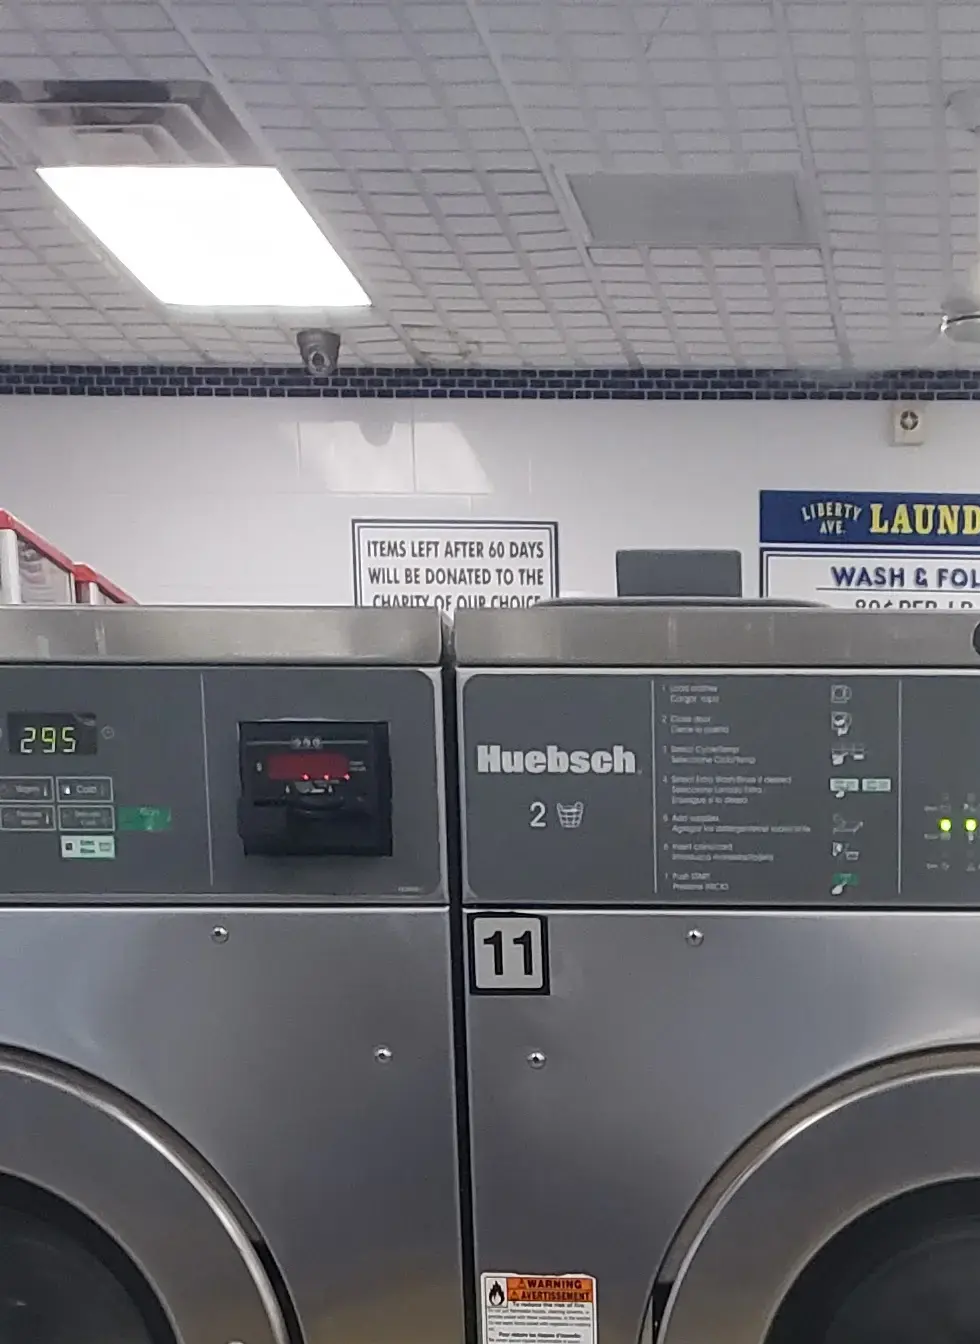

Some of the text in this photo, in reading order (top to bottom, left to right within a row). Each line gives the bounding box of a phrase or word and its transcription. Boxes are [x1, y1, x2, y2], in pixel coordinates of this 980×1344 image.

[801, 500, 862, 522] LIBERTY
[367, 540, 544, 558] ITEMS LEFT AFTER 60 DAYS
[368, 568, 544, 585] WILL BE DONATED TO THE
[831, 566, 904, 587] WASH
[916, 568, 928, 588] &
[434, 594, 451, 610] OF
[20, 727, 76, 753] 295
[477, 744, 636, 774] Huebsch
[530, 802, 546, 827] 2
[483, 930, 533, 976] 11
[527, 1279, 582, 1289] WARNING
[521, 1290, 590, 1301] AVERTISSEMENT
